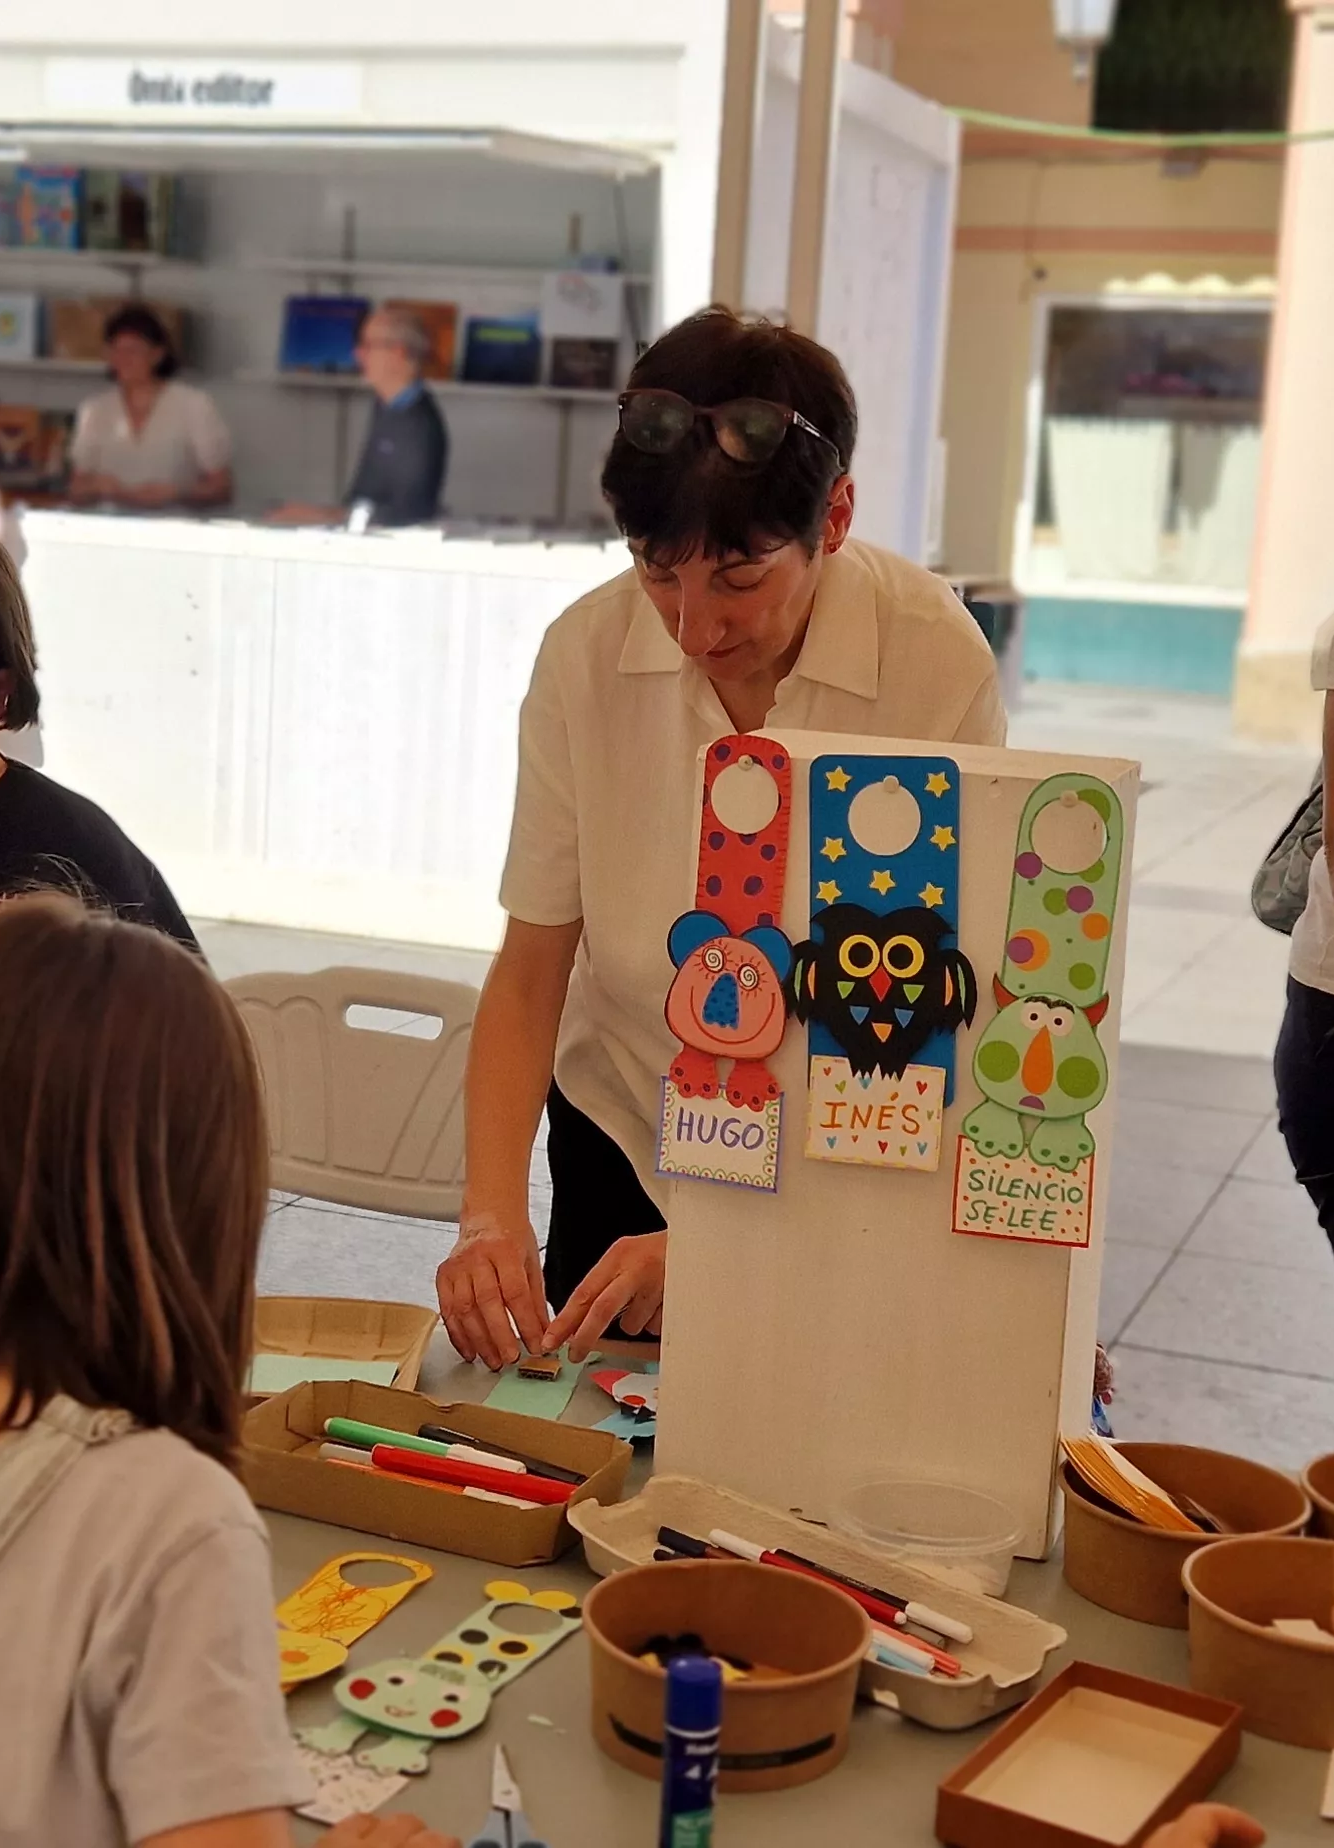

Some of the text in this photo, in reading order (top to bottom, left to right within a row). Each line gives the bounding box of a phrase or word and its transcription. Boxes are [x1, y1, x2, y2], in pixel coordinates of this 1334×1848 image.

[677, 1106, 764, 1150] HUGO
[820, 1091, 920, 1135] INÉS
[966, 1200, 1057, 1231] SE LEE
